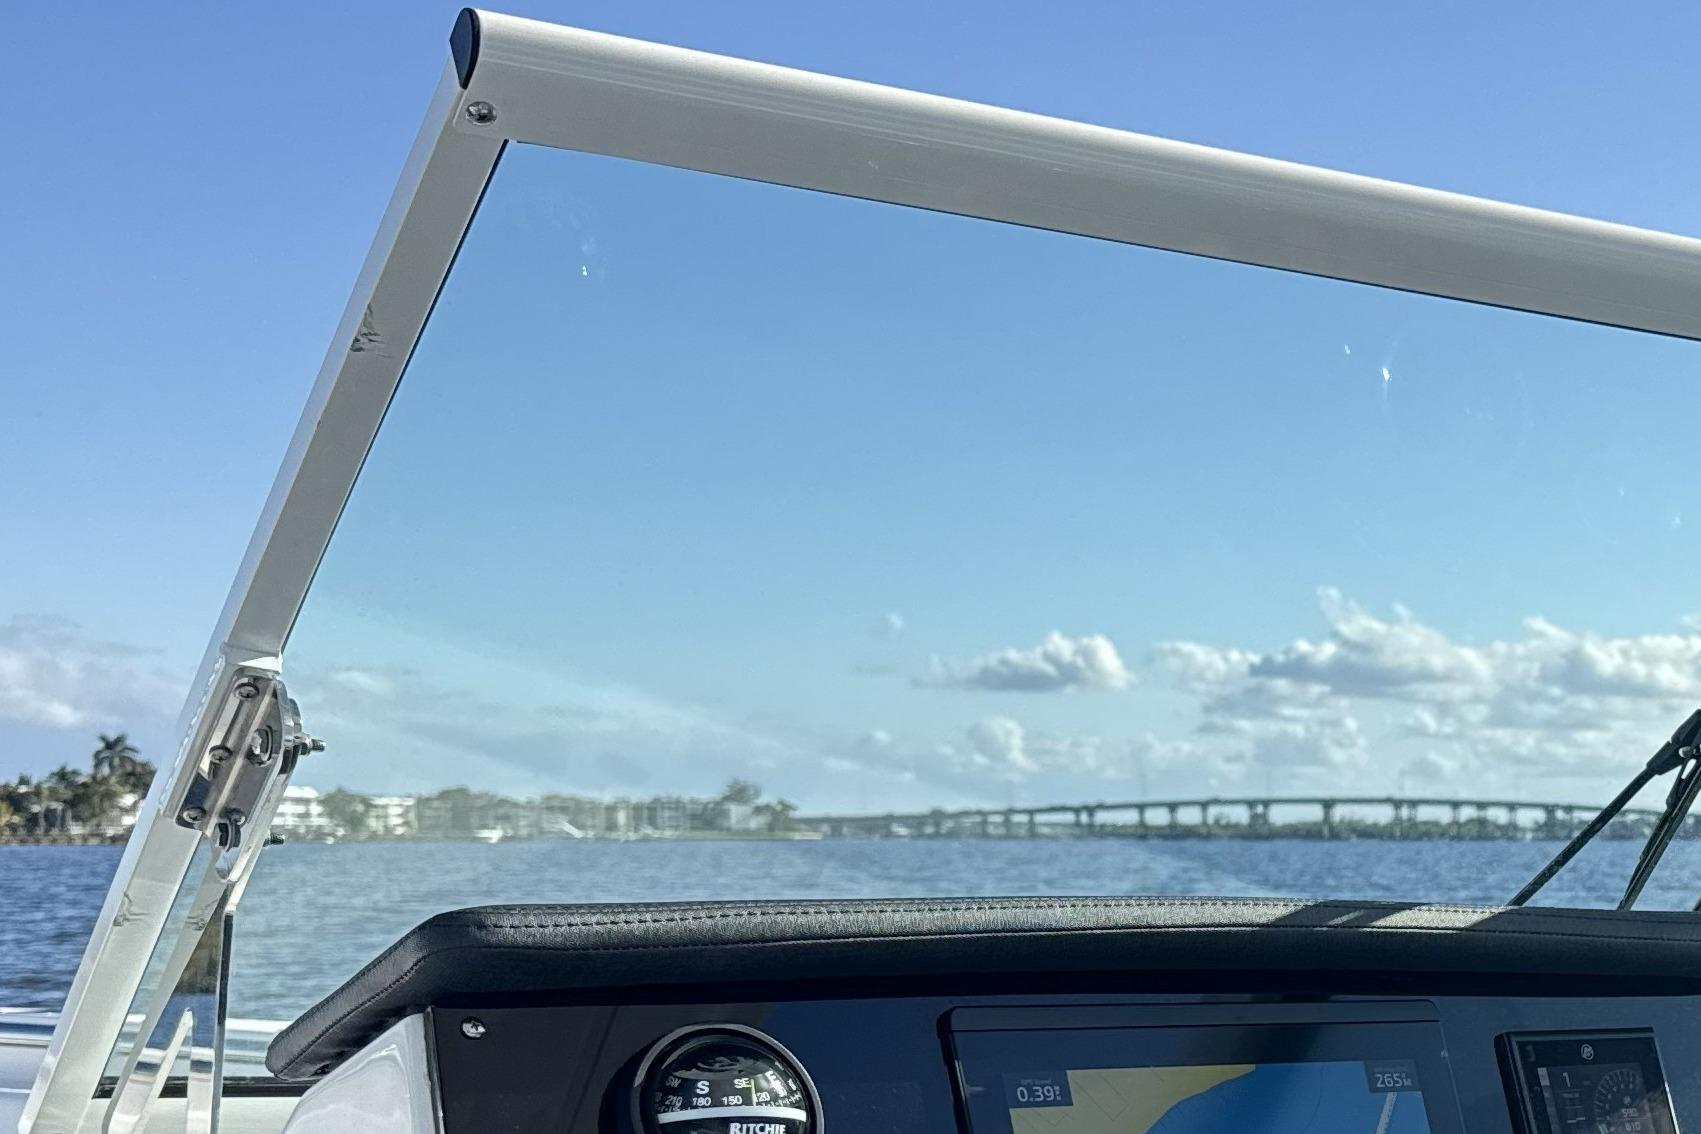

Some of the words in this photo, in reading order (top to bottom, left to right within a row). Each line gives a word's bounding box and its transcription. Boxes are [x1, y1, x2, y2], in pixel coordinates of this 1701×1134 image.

[696, 1080, 710, 1095] S
[733, 1077, 752, 1089] SE
[1375, 1073, 1401, 1088] 265
[665, 1094, 683, 1107] 210
[692, 1096, 711, 1107] 180
[721, 1095, 743, 1106] 150
[1016, 1086, 1055, 1103] 0.39
